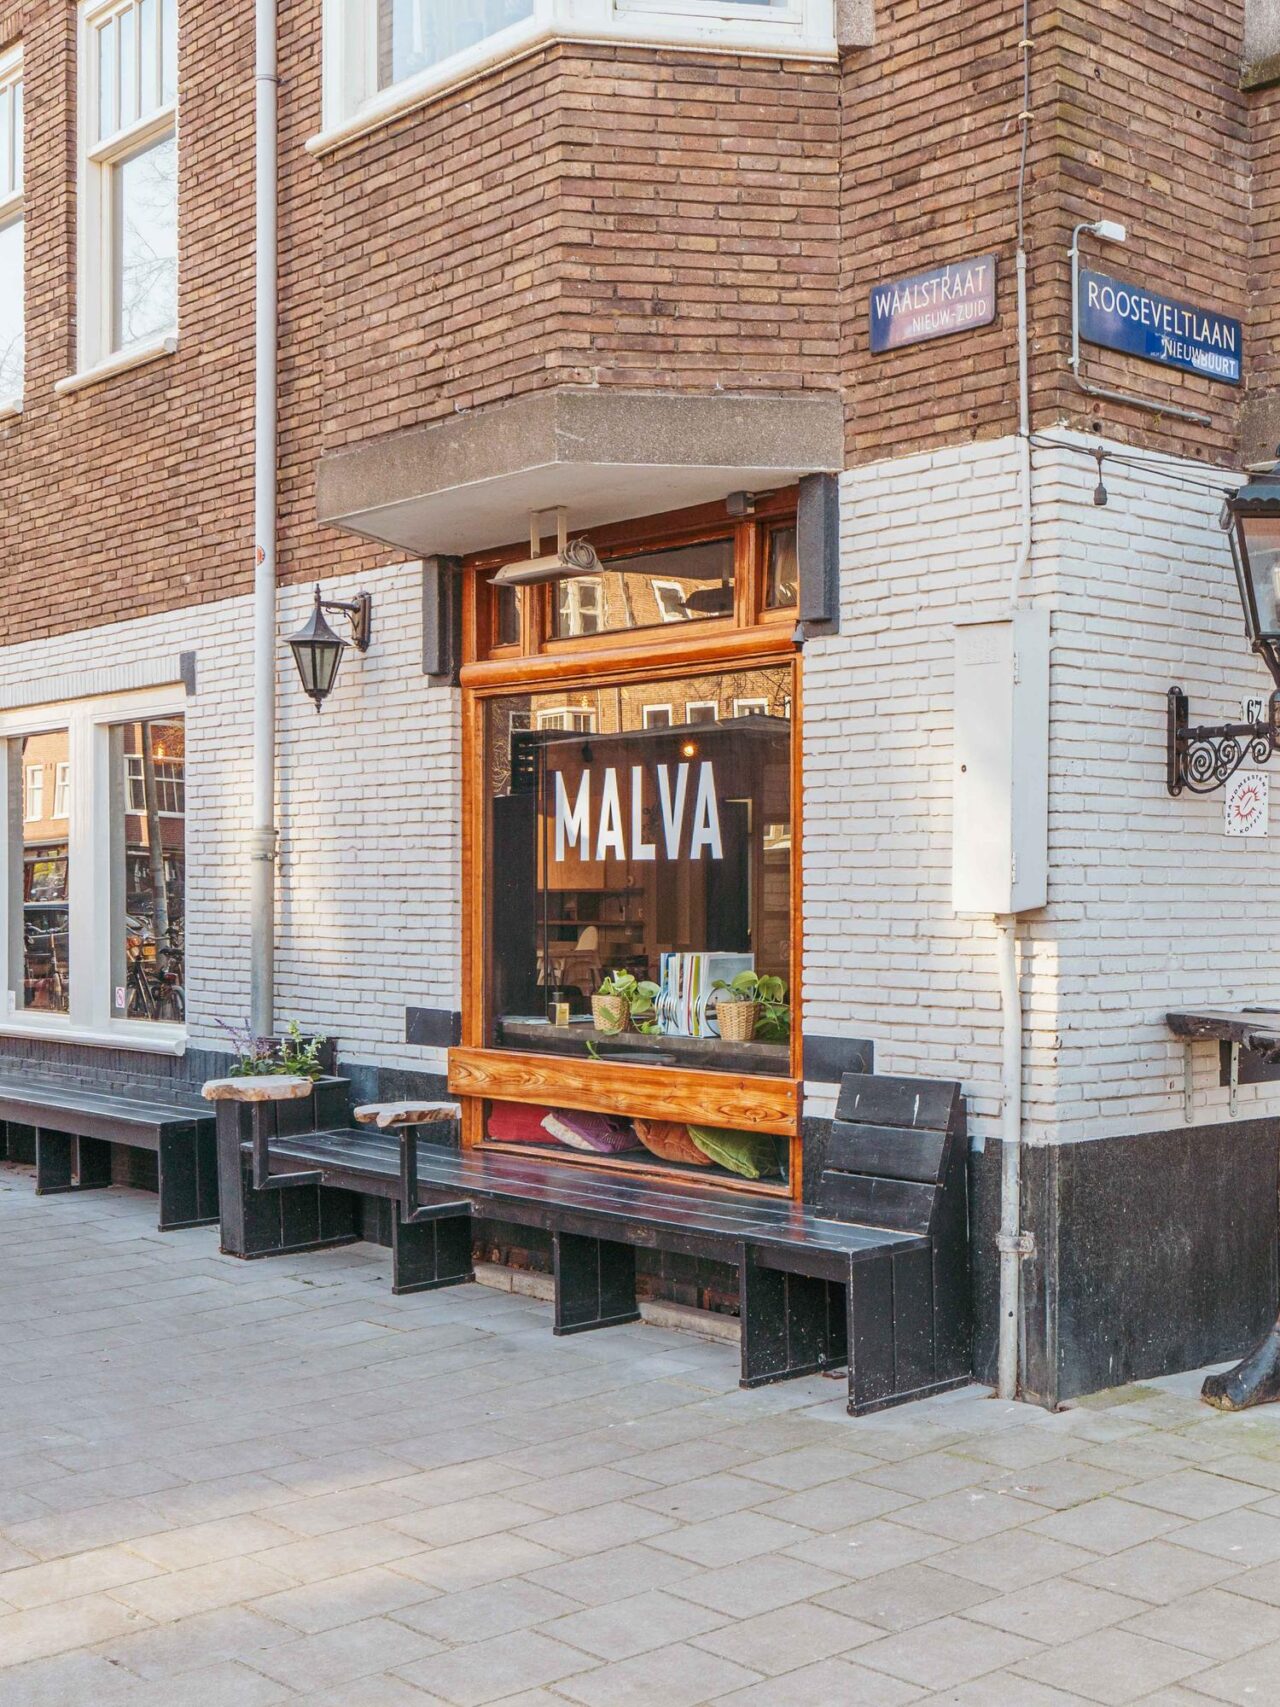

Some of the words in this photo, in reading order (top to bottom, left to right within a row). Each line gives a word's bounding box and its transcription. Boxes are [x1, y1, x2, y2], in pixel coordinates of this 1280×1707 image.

[875, 265, 987, 320] WAALSTRAAT
[912, 299, 986, 334] NIEUW-ZUID
[1087, 280, 1236, 352] ROOSEVELTLAAN
[554, 761, 724, 862] MALVA
